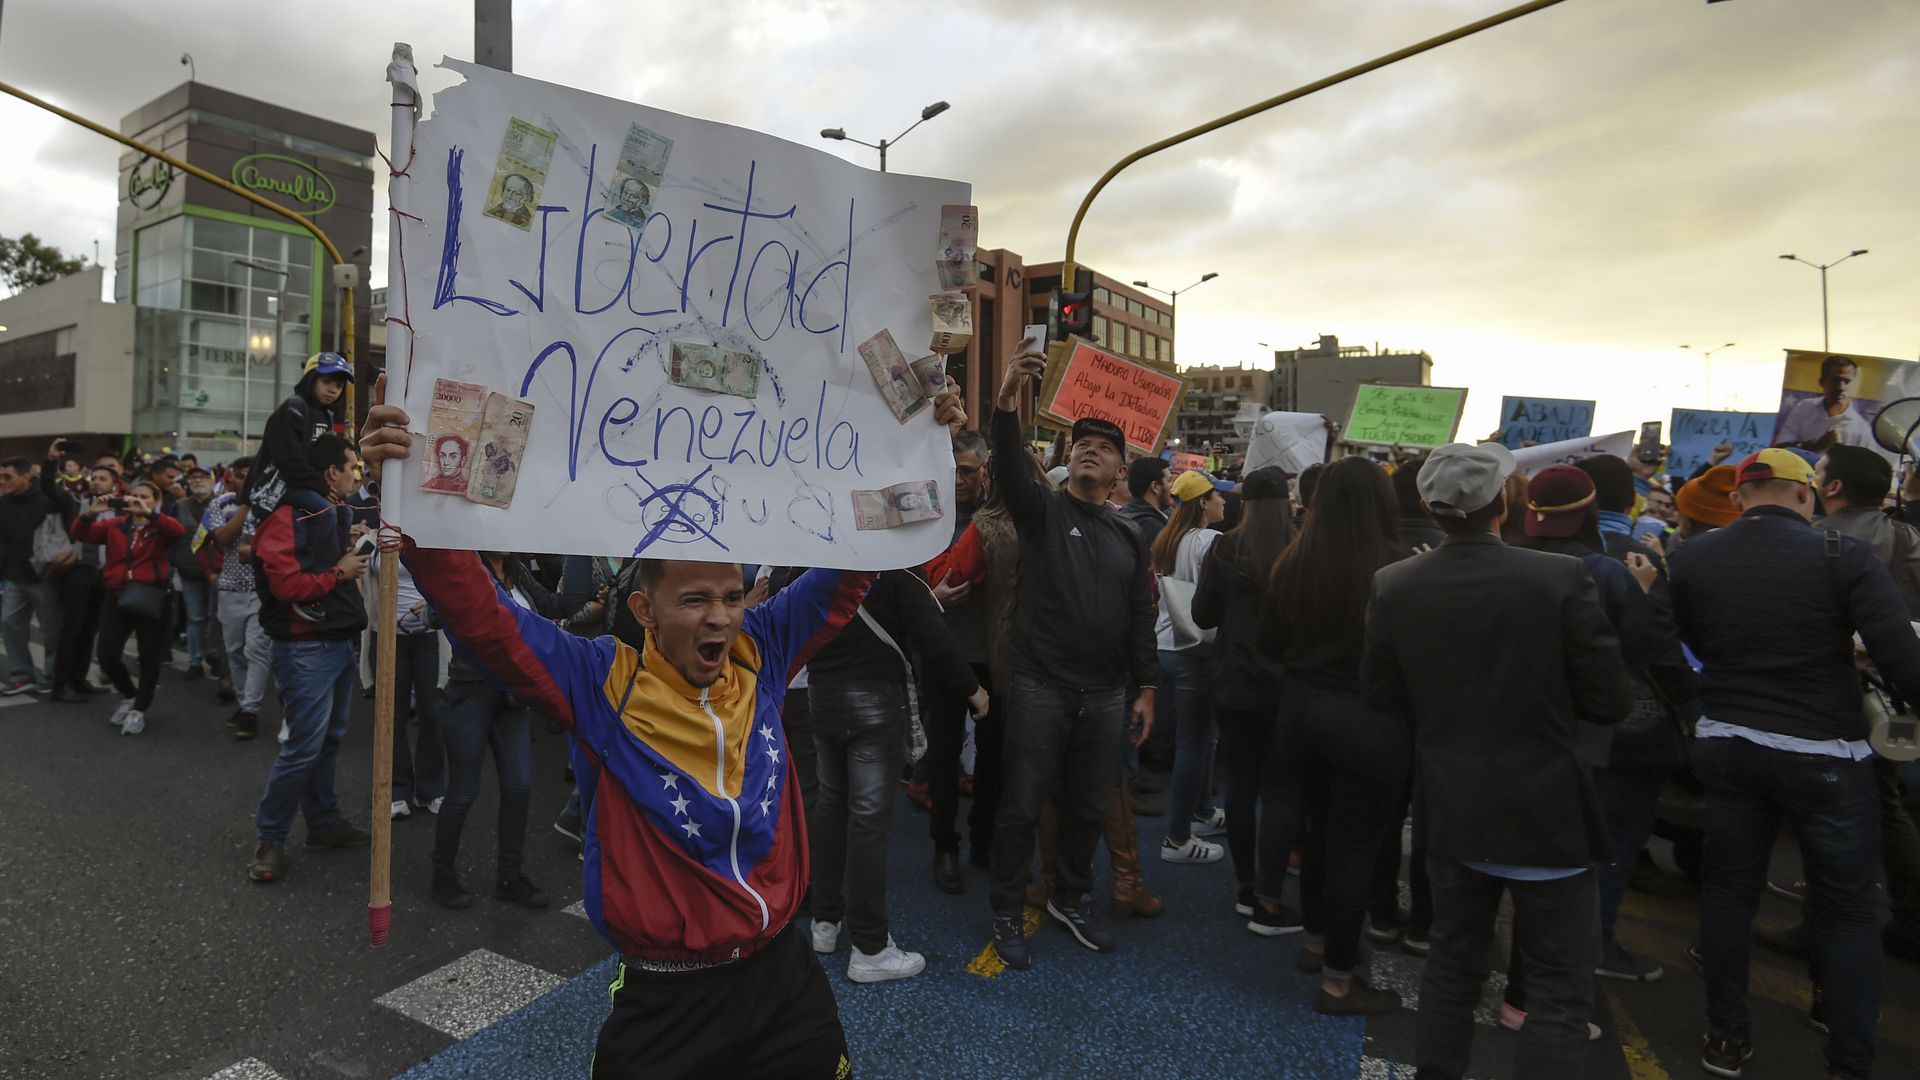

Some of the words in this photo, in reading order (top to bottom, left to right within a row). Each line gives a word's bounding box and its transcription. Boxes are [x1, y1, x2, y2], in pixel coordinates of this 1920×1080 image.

[241, 166, 329, 203] Carulla
[961, 215, 971, 229] 20
[1074, 371, 1101, 398] Abajo
[434, 391, 462, 404] 20000
[520, 327, 863, 483] Venezuela
[510, 410, 524, 429] 20
